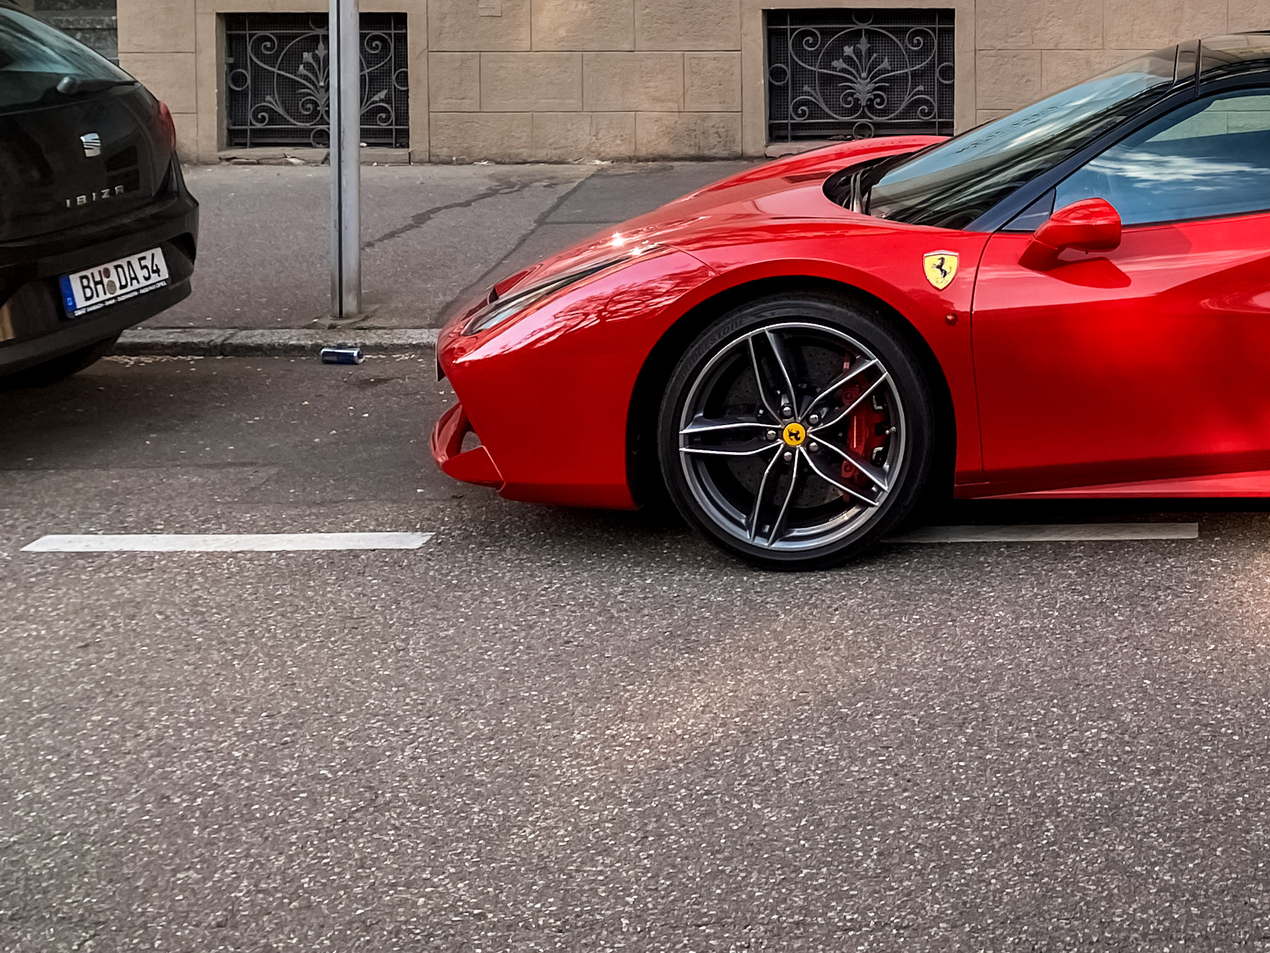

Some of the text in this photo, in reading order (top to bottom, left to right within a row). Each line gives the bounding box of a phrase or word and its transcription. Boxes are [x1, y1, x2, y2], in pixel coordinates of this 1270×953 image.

[66, 185, 124, 208] IBIZA
[79, 270, 107, 302] BH
[113, 260, 140, 291] DA
[137, 252, 161, 282] 54
